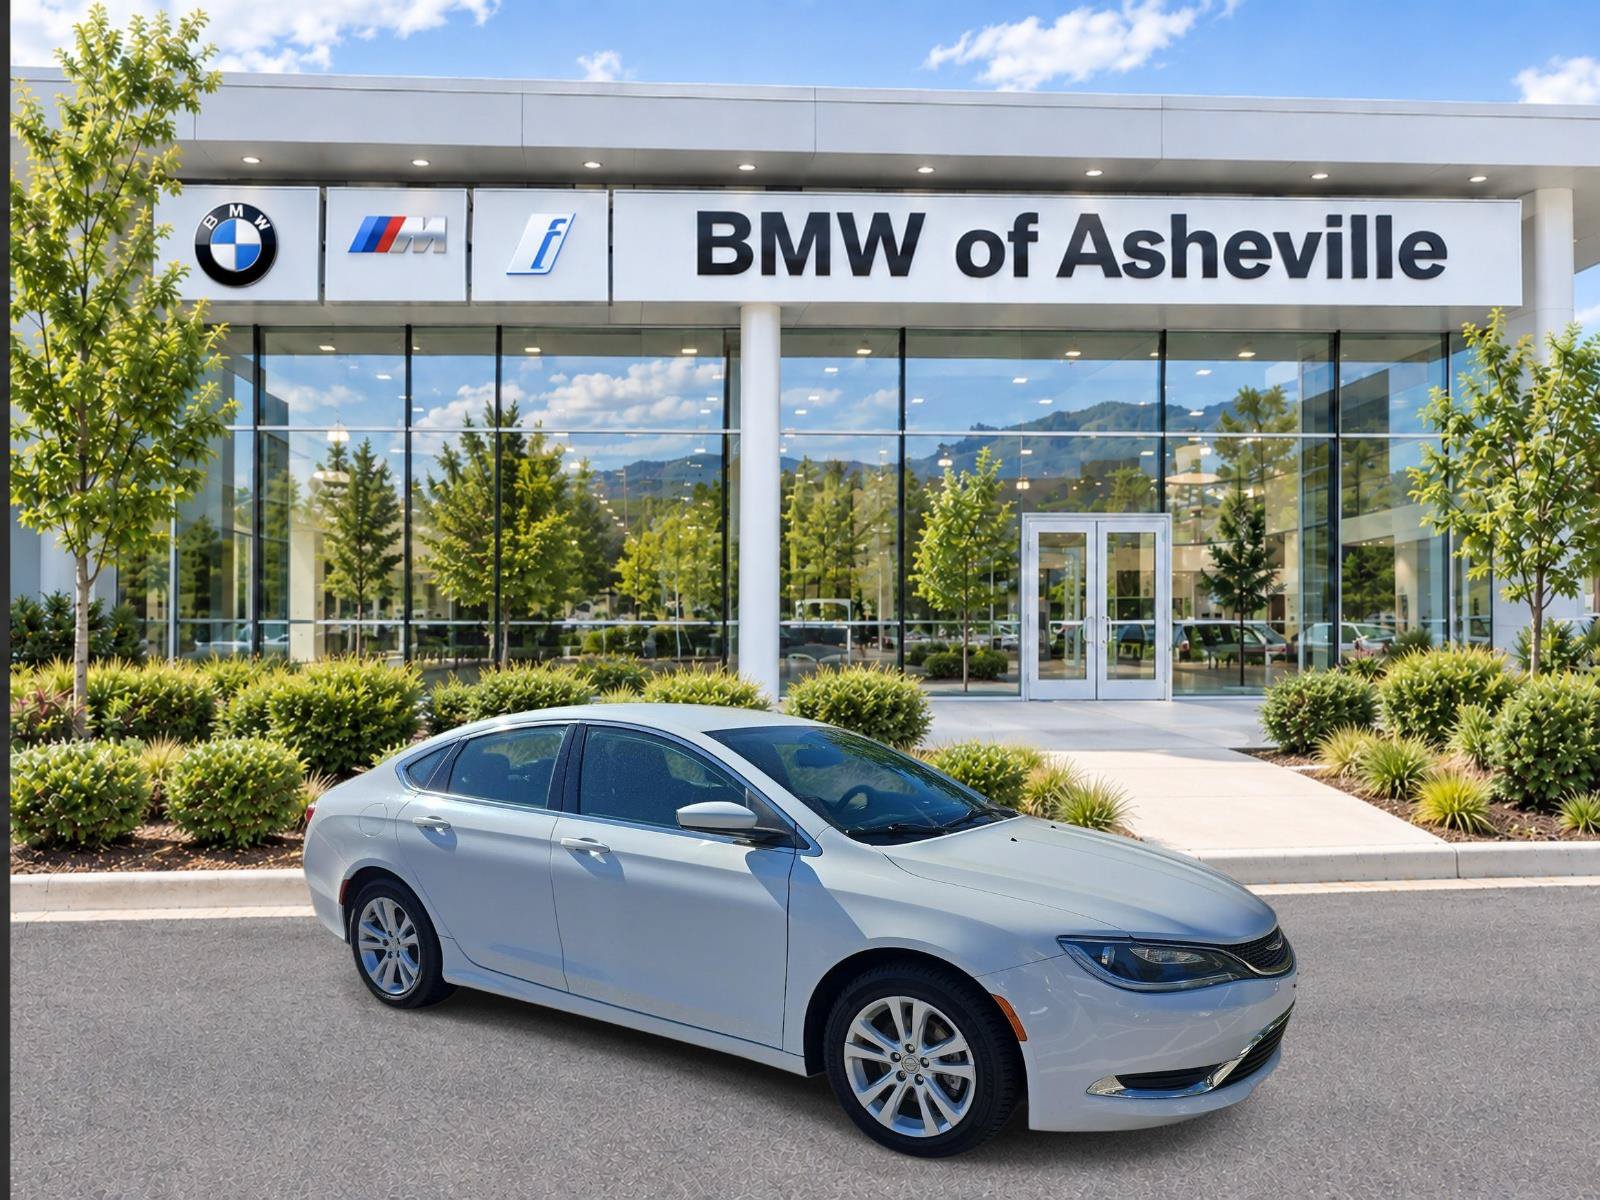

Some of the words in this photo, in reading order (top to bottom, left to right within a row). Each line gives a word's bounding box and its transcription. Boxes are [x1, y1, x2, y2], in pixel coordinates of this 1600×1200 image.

[202, 204, 271, 231] BMW
[389, 216, 447, 254] M
[697, 211, 926, 277] BMW
[955, 212, 1039, 279] of
[1056, 214, 1448, 280] Asheville
